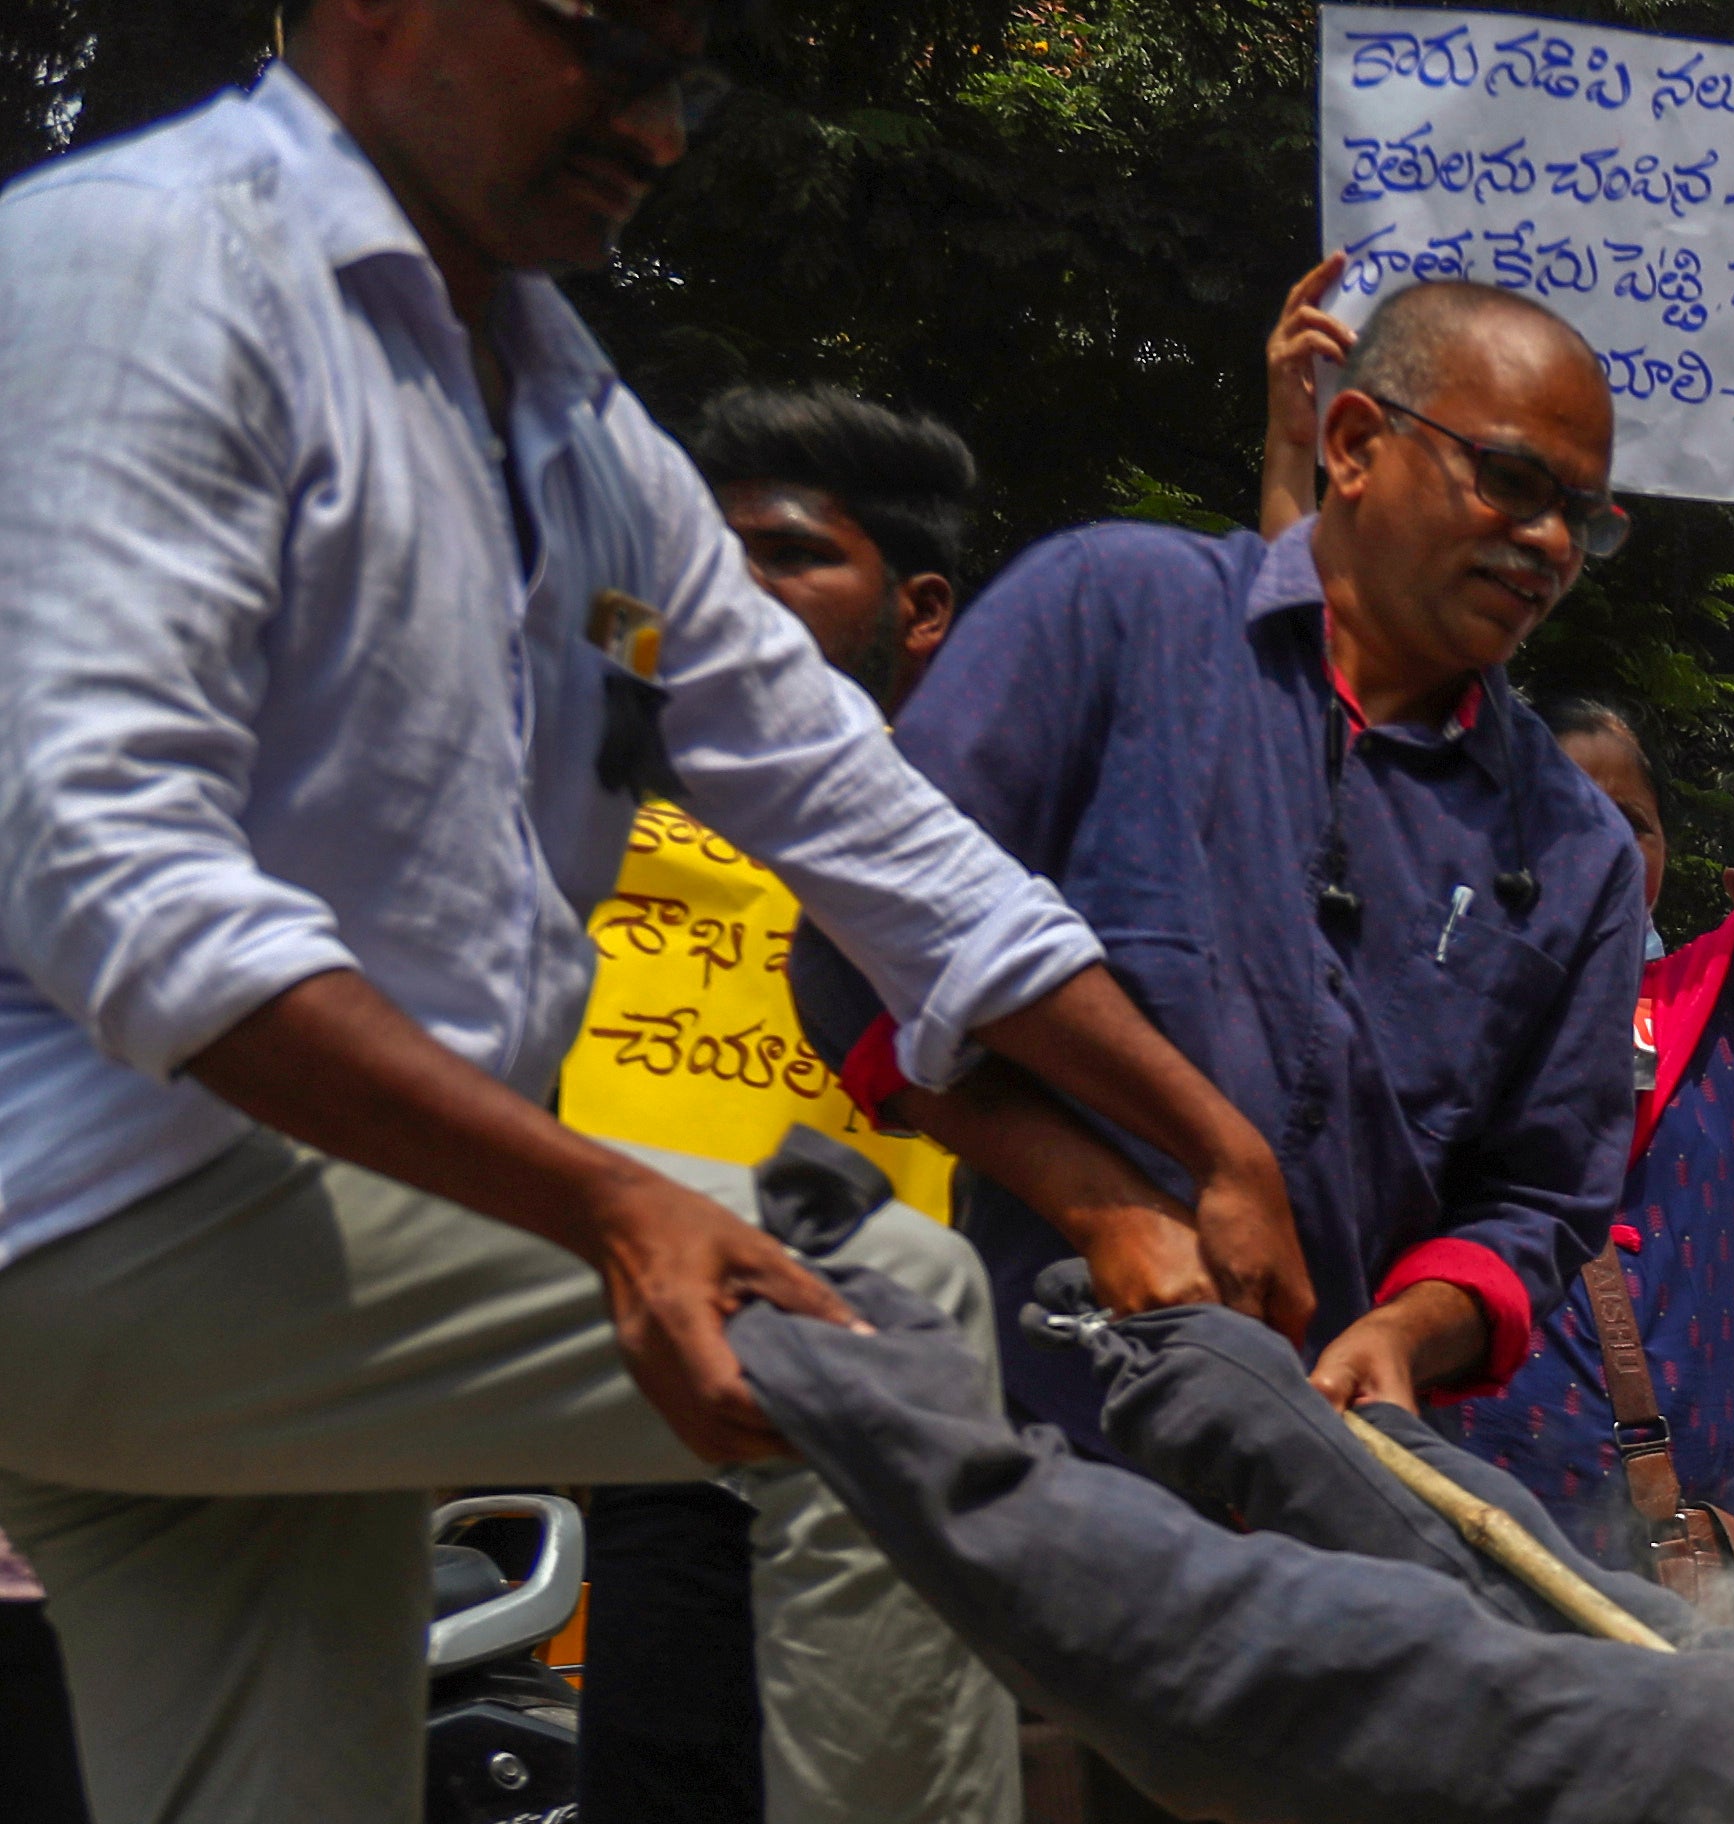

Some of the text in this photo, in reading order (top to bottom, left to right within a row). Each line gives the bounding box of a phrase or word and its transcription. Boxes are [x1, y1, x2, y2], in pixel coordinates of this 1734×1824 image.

[1346, 26, 1478, 89] కారు
[1485, 31, 1631, 108] నడిపి
[1341, 123, 1535, 203] రైతులను
[1545, 147, 1718, 220] చంపిన
[1484, 220, 1597, 296] కేసు
